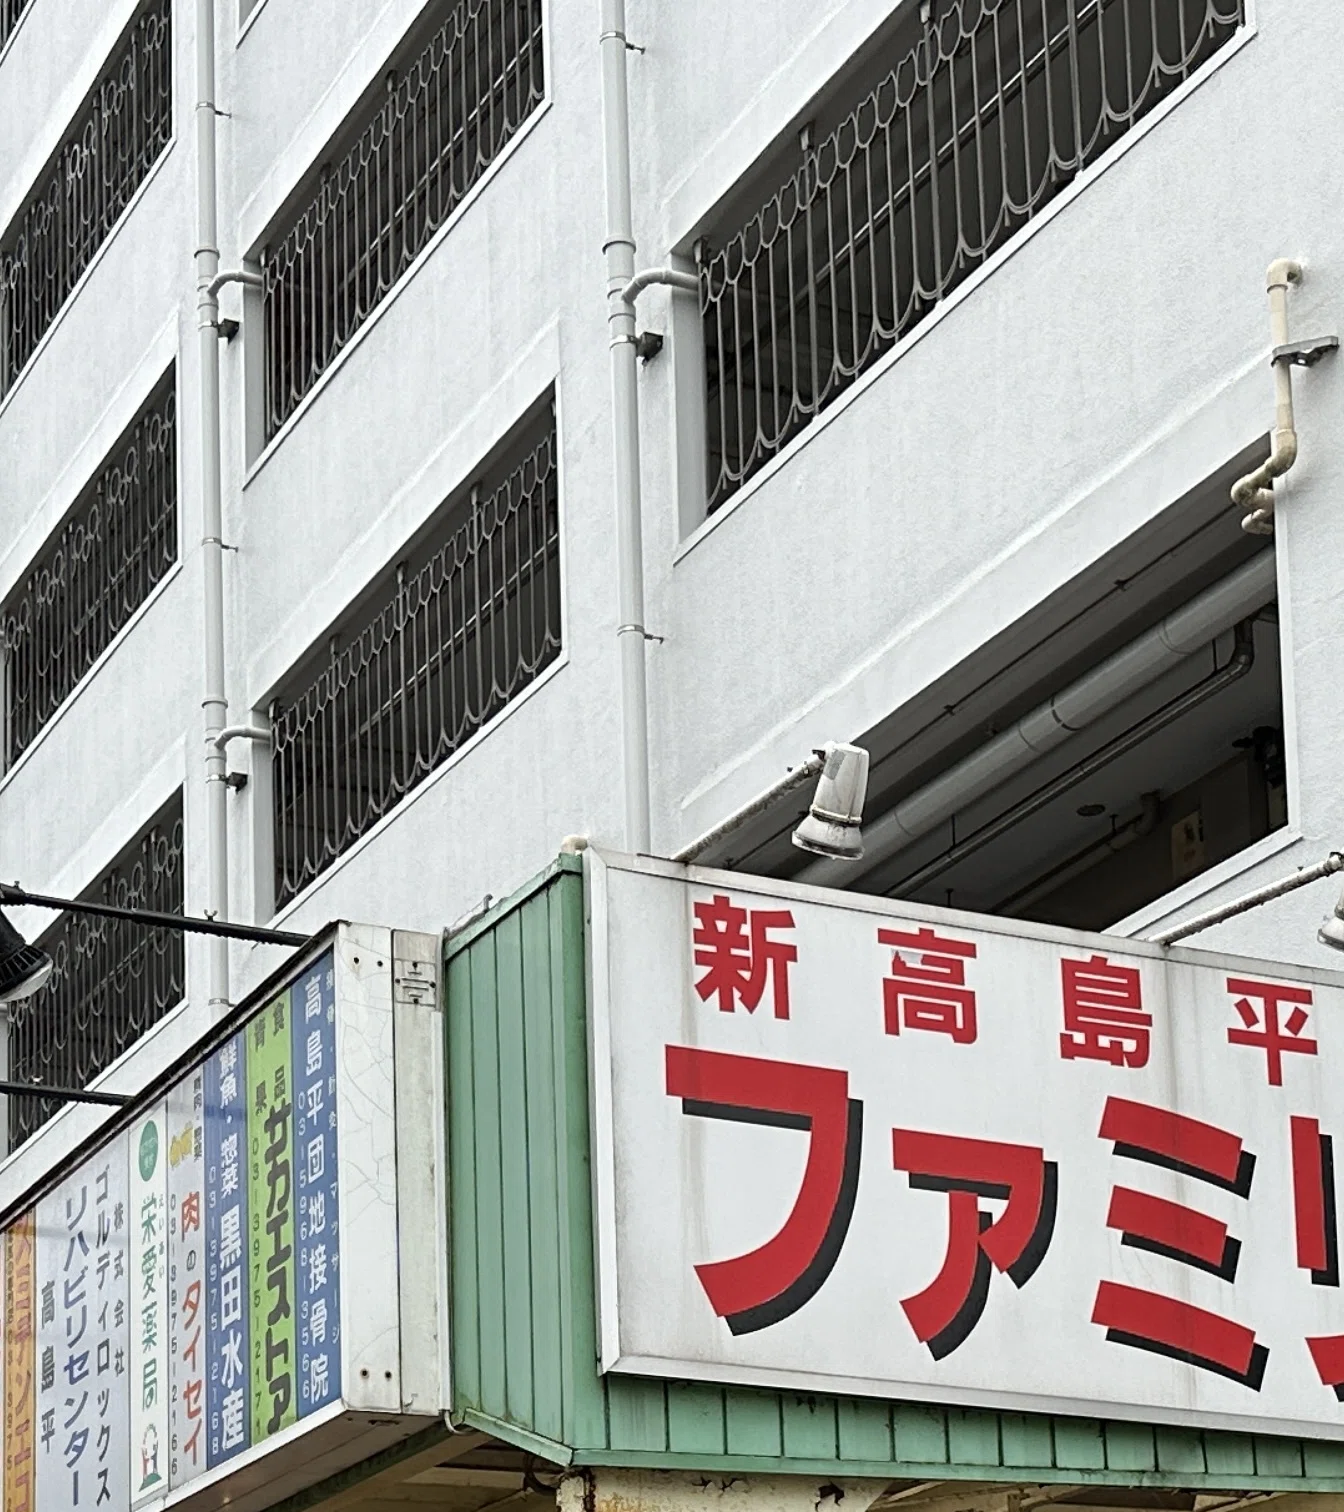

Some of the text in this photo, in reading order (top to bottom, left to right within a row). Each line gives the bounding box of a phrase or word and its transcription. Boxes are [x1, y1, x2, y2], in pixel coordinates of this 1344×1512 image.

[272, 998, 285, 1103] 食品
[693, 895, 1318, 1086] 新高島平
[113, 1197, 124, 1379] 株式会社
[141, 1187, 157, 1414] 栄愛薬局
[264, 1092, 294, 1436] サカエストア
[305, 968, 328, 1406] 高島平団地接骨院
[40, 1275, 55, 1457] 高島平
[63, 1181, 89, 1512] リハビリセンター
[96, 1162, 110, 1507] ゴルディロックス
[181, 1185, 202, 1472] 肉のタイセイ
[219, 1200, 244, 1453] 黒田水産
